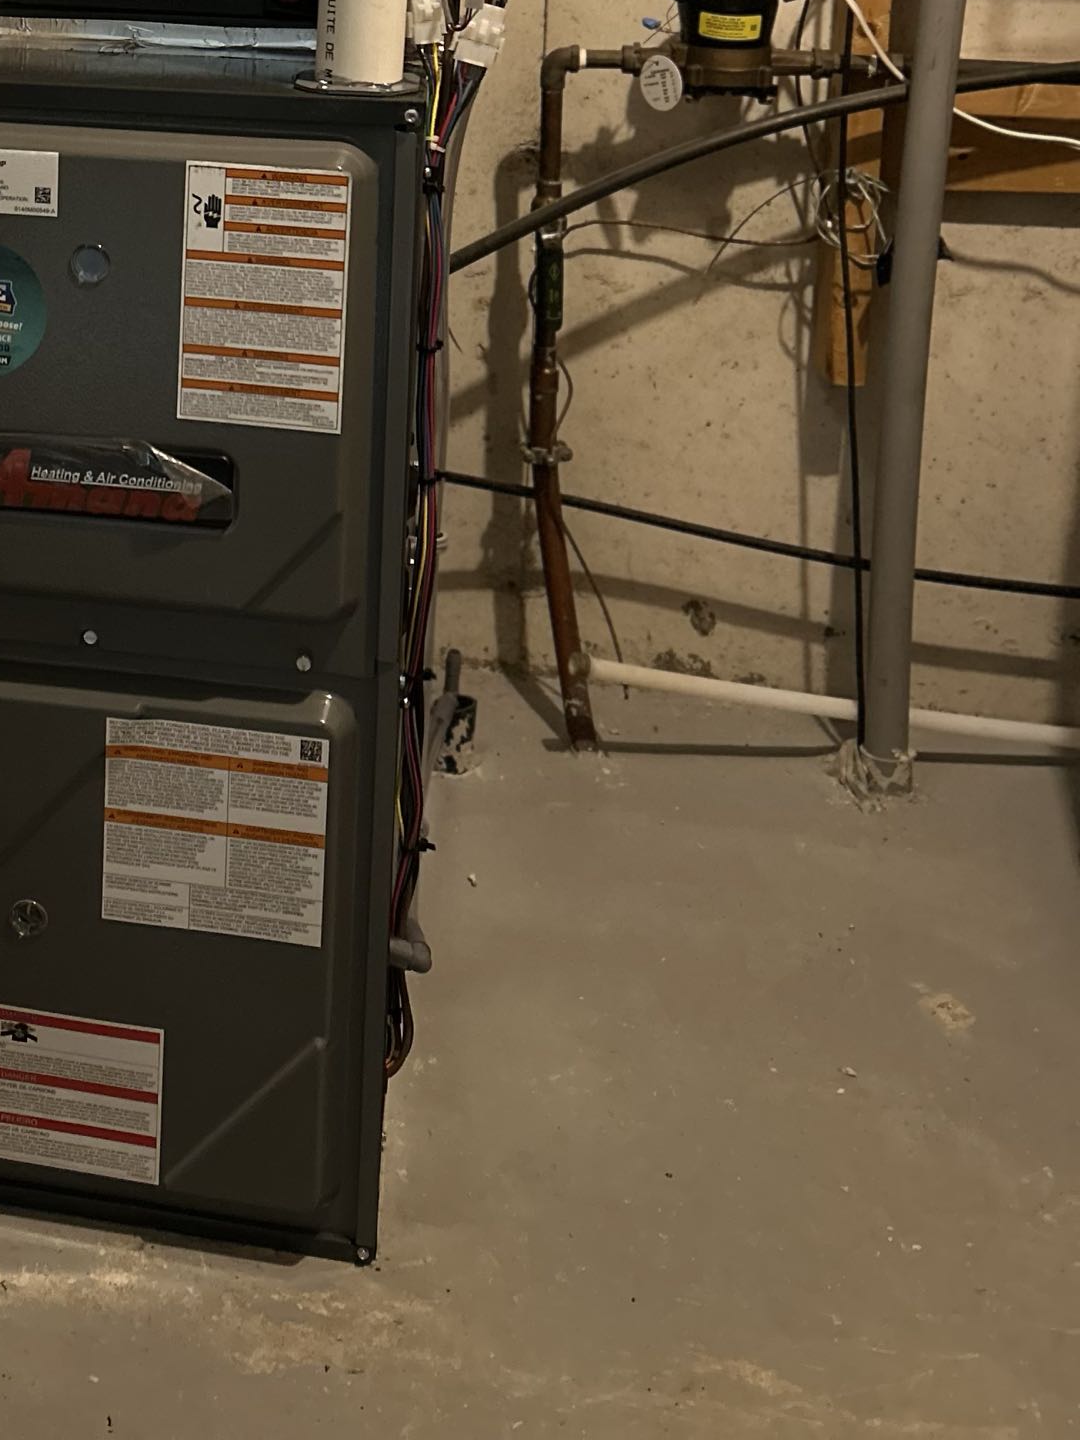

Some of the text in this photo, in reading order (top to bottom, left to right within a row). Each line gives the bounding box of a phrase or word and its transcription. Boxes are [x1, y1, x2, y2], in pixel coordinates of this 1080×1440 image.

[325, 42, 335, 61] DE
[31, 465, 203, 495] Heating & Air Conditioning
